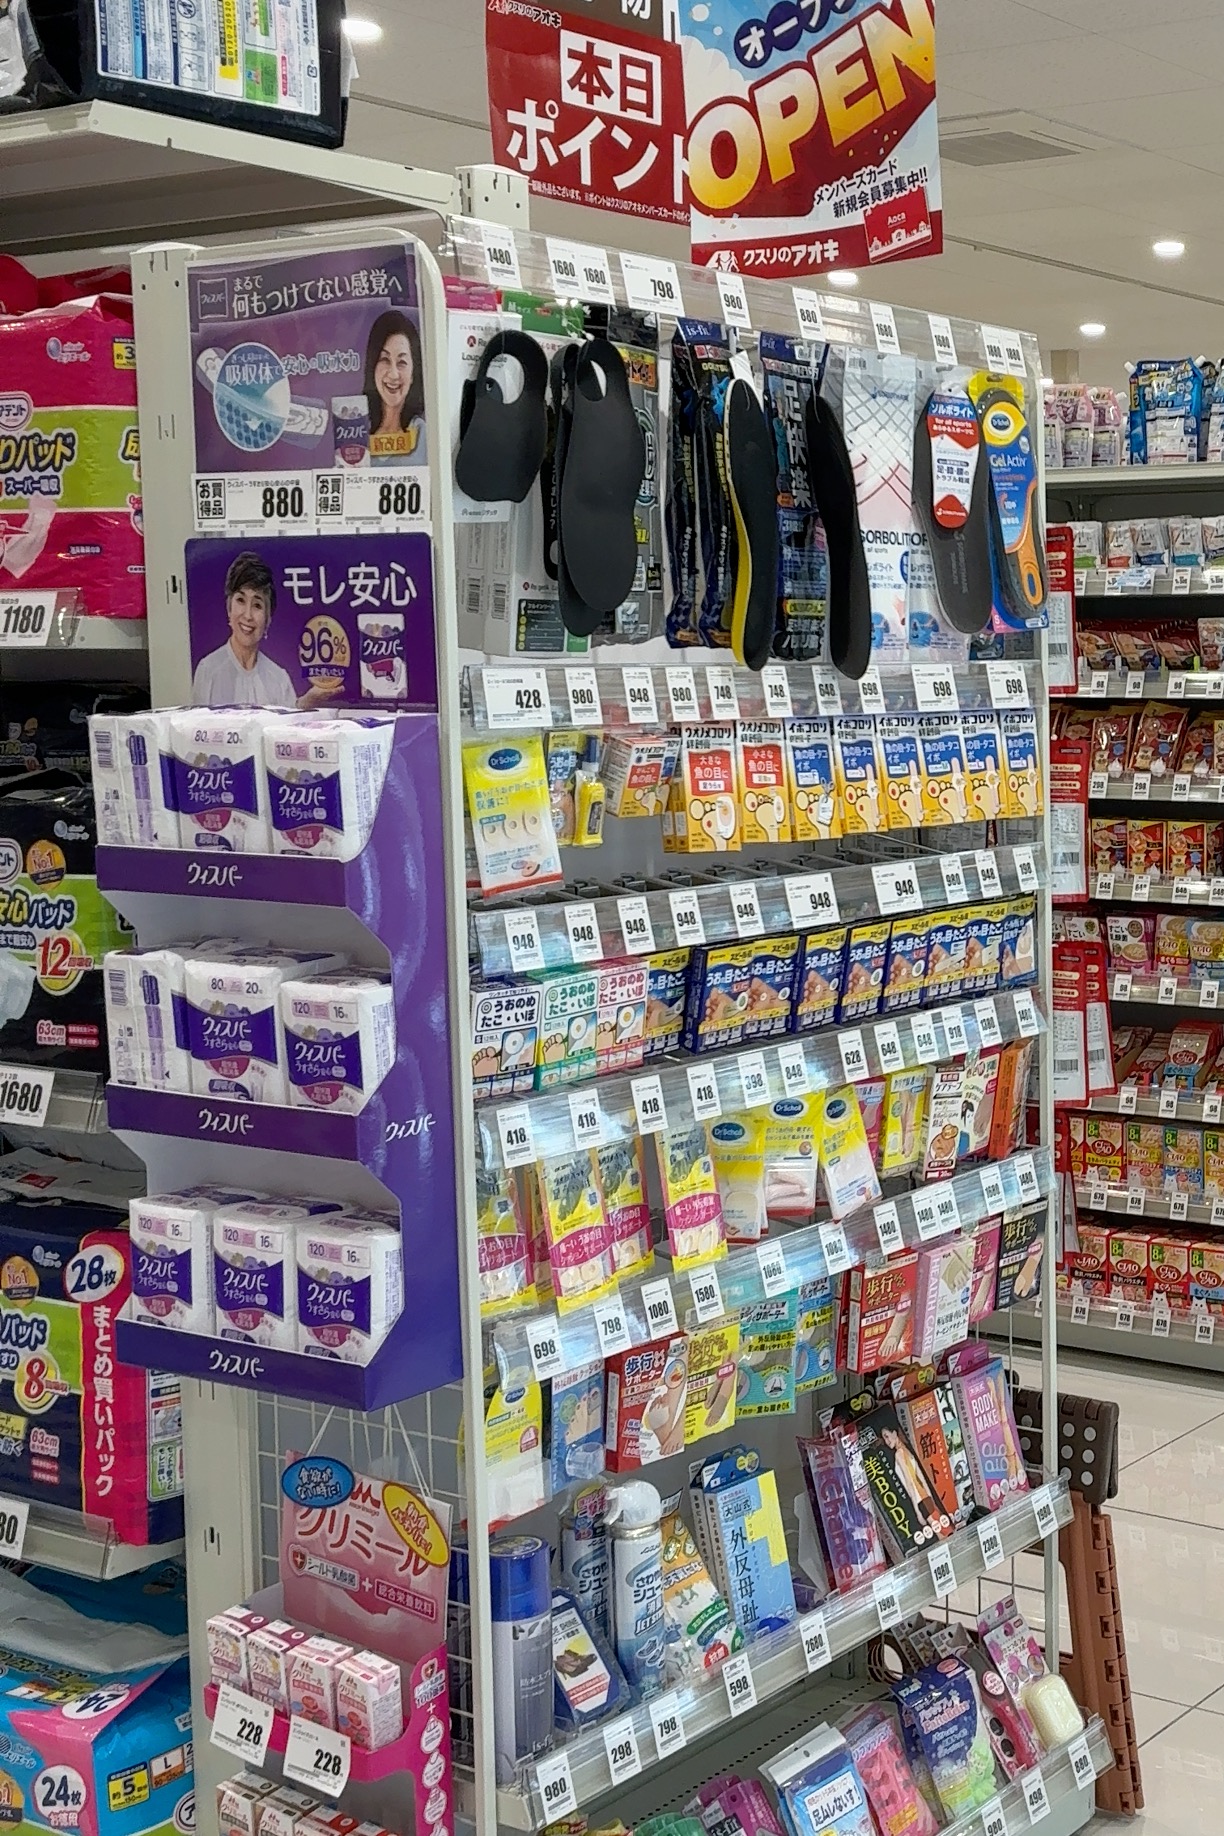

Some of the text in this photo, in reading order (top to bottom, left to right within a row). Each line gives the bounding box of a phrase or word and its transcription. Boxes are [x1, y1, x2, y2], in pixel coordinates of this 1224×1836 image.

[506, 2, 561, 28] クスリのアオキ
[566, 40, 655, 120] 本日
[688, 0, 936, 210] OPEN
[506, 98, 689, 205] ポイント
[814, 159, 898, 206] メンバーズカード
[833, 167, 929, 219] 新規会員募集中!!
[487, 247, 512, 266] 1480
[742, 239, 839, 267] クスリのアオキ
[552, 258, 576, 278] 1680
[232, 274, 263, 292] まるで
[650, 279, 674, 299] 798
[232, 268, 403, 320] 何もつけてない感覚へ
[723, 292, 743, 311] 980
[800, 308, 818, 325] 880
[930, 400, 975, 419] ソルボライト
[199, 479, 223, 500] お買
[379, 483, 421, 515] 880
[262, 486, 304, 518] 880
[282, 561, 418, 608] モレ安心
[3, 605, 45, 635] 1180
[300, 627, 348, 663] 96%
[515, 689, 542, 709] 428
[572, 689, 594, 705] 980
[629, 687, 650, 703] 948
[819, 682, 836, 697] 648
[933, 680, 952, 697] 698
[788, 720, 827, 735] イボコロリ
[837, 717, 872, 731] イボコロリ
[187, 770, 234, 789] ウィスパー
[694, 766, 729, 780] 魚の目に
[278, 786, 327, 805] ウィスパー
[187, 862, 243, 887] ウィスパー
[512, 933, 535, 952] 948
[38, 936, 70, 977] 12
[559, 983, 596, 1000] うおのめ
[494, 997, 536, 1013] うおのめ
[38, 1022, 65, 1037] 63cm
[481, 1012, 536, 1028] たこ・いぼ
[845, 1050, 862, 1064] 628
[881, 1041, 897, 1056] 648
[198, 1109, 254, 1135] ウィスパー
[385, 1113, 436, 1142] ウィスパー
[578, 1112, 597, 1129] 418
[506, 1127, 527, 1146] 418
[917, 1207, 934, 1222] 1480
[70, 1256, 117, 1294] 28枚
[695, 1285, 717, 1303] 1580
[648, 1300, 669, 1320] 1080
[602, 1317, 622, 1336] 798
[534, 1339, 556, 1360] 698
[208, 1350, 265, 1379] ウィスパー
[625, 1352, 655, 1376] 歩行
[23, 1357, 46, 1400] 8
[625, 1369, 662, 1387] サポーター
[92, 1304, 115, 1497] まとめ買いパック
[971, 1391, 996, 1418] BODY
[975, 1409, 999, 1434] MAKE
[299, 1466, 332, 1484] 食欲が
[864, 1456, 914, 1539] 美BODY
[298, 1506, 429, 1578] クリミール
[306, 1557, 357, 1588] シールド乳酸菌
[728, 1525, 759, 1626] 外反母趾
[933, 1562, 950, 1583] 1980
[377, 1582, 435, 1618] 総合栄養飲料
[804, 1633, 825, 1655] 2680
[729, 1676, 750, 1697] 598
[237, 1717, 262, 1746] 228
[315, 1747, 341, 1777] 228
[611, 1740, 633, 1763] 298
[41, 1774, 82, 1807] 24枚
[1029, 1789, 1045, 1807] 498
